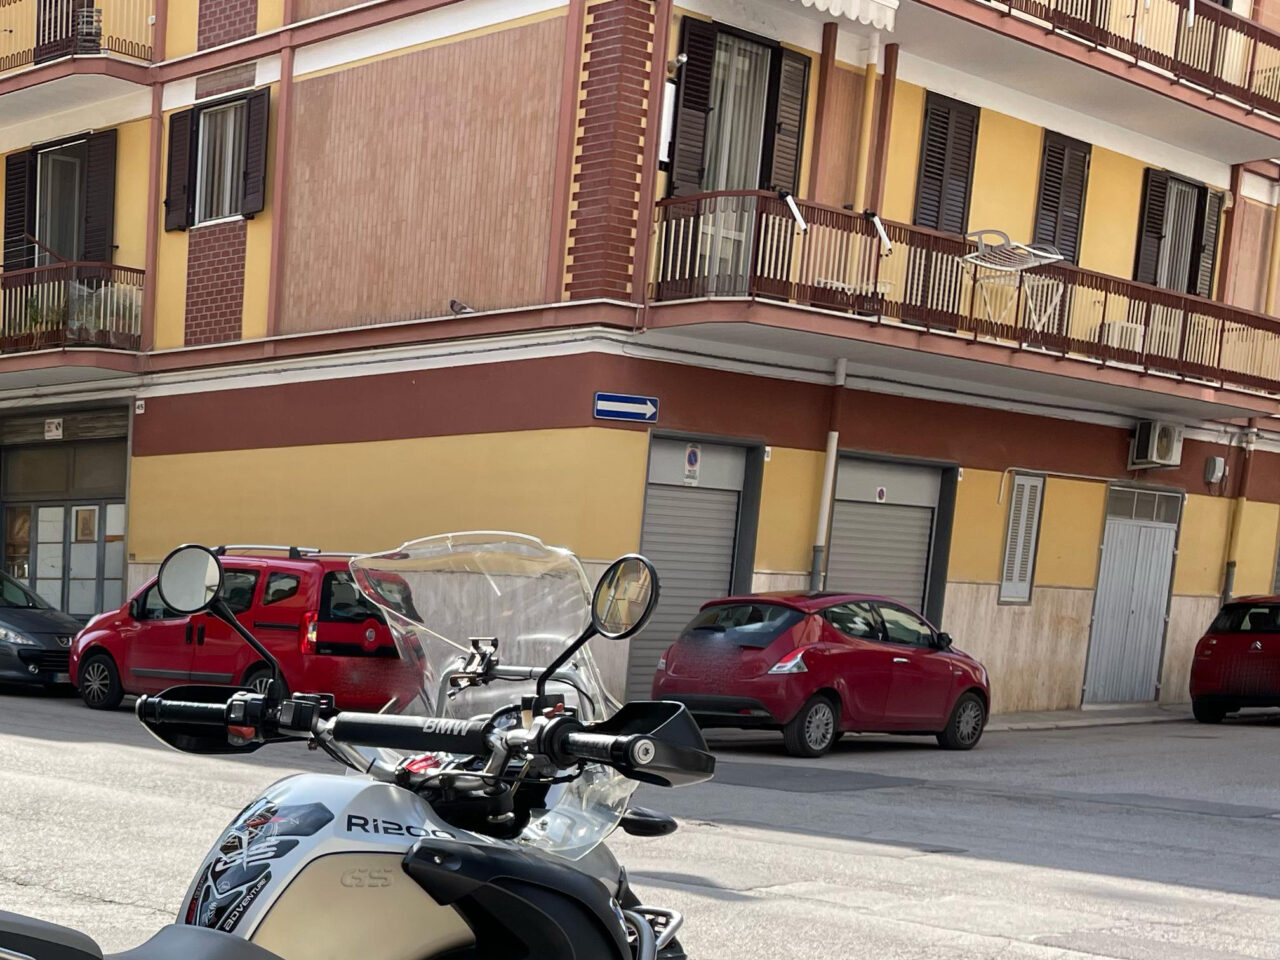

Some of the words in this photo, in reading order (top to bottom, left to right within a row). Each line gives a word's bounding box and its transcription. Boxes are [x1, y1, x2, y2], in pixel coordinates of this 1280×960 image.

[423, 719, 471, 736] BMW
[346, 814, 457, 840] R1200
[340, 867, 394, 888] GS
